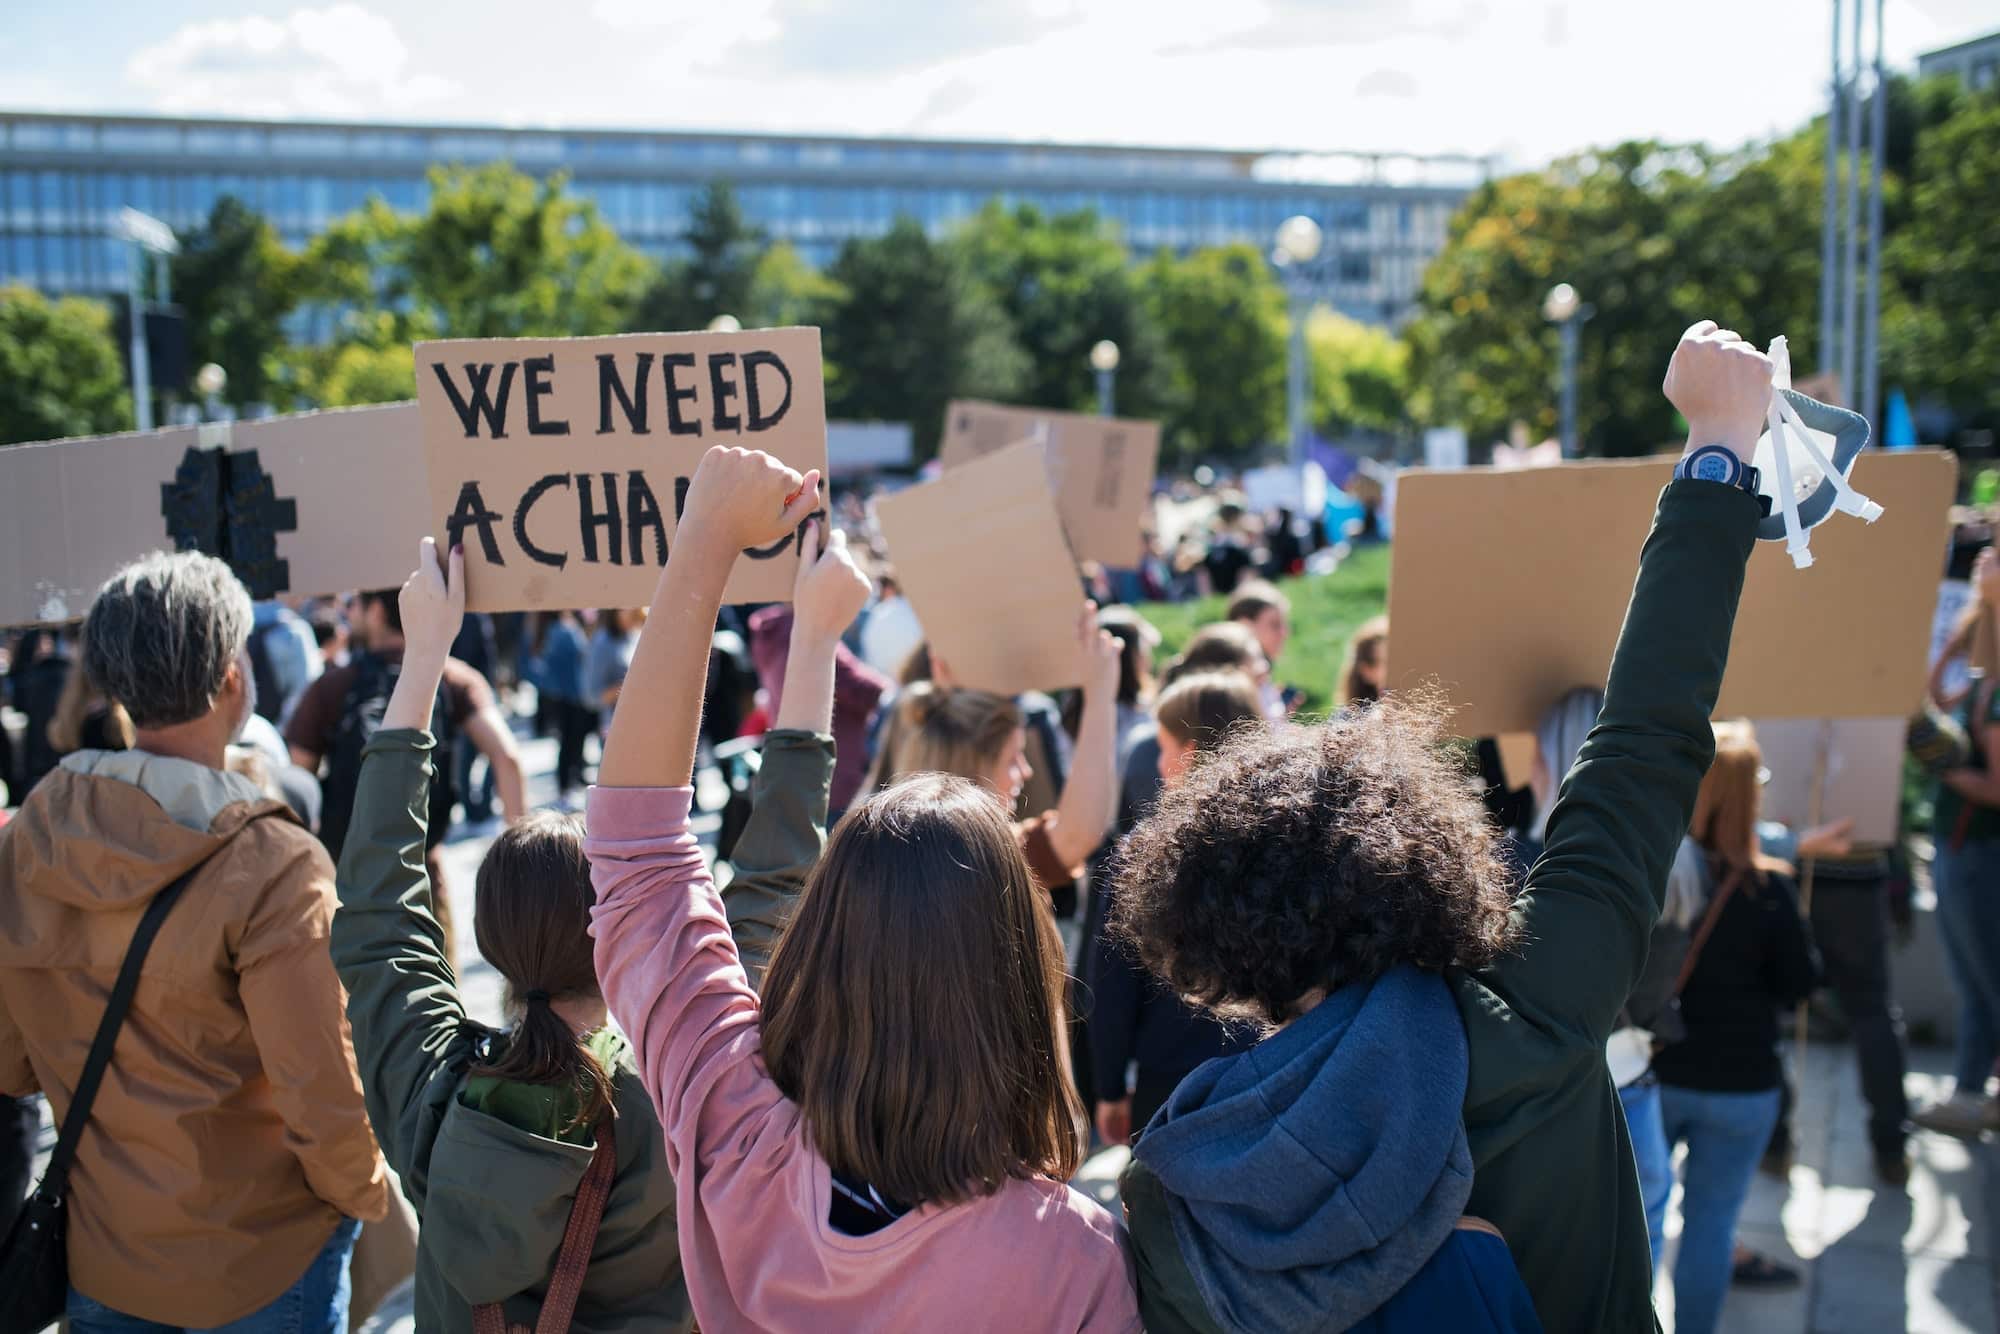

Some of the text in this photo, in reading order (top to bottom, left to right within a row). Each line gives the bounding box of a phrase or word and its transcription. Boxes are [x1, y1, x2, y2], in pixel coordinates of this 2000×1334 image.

[432, 350, 793, 439] WE NEED
[446, 470, 826, 570] A CHA
